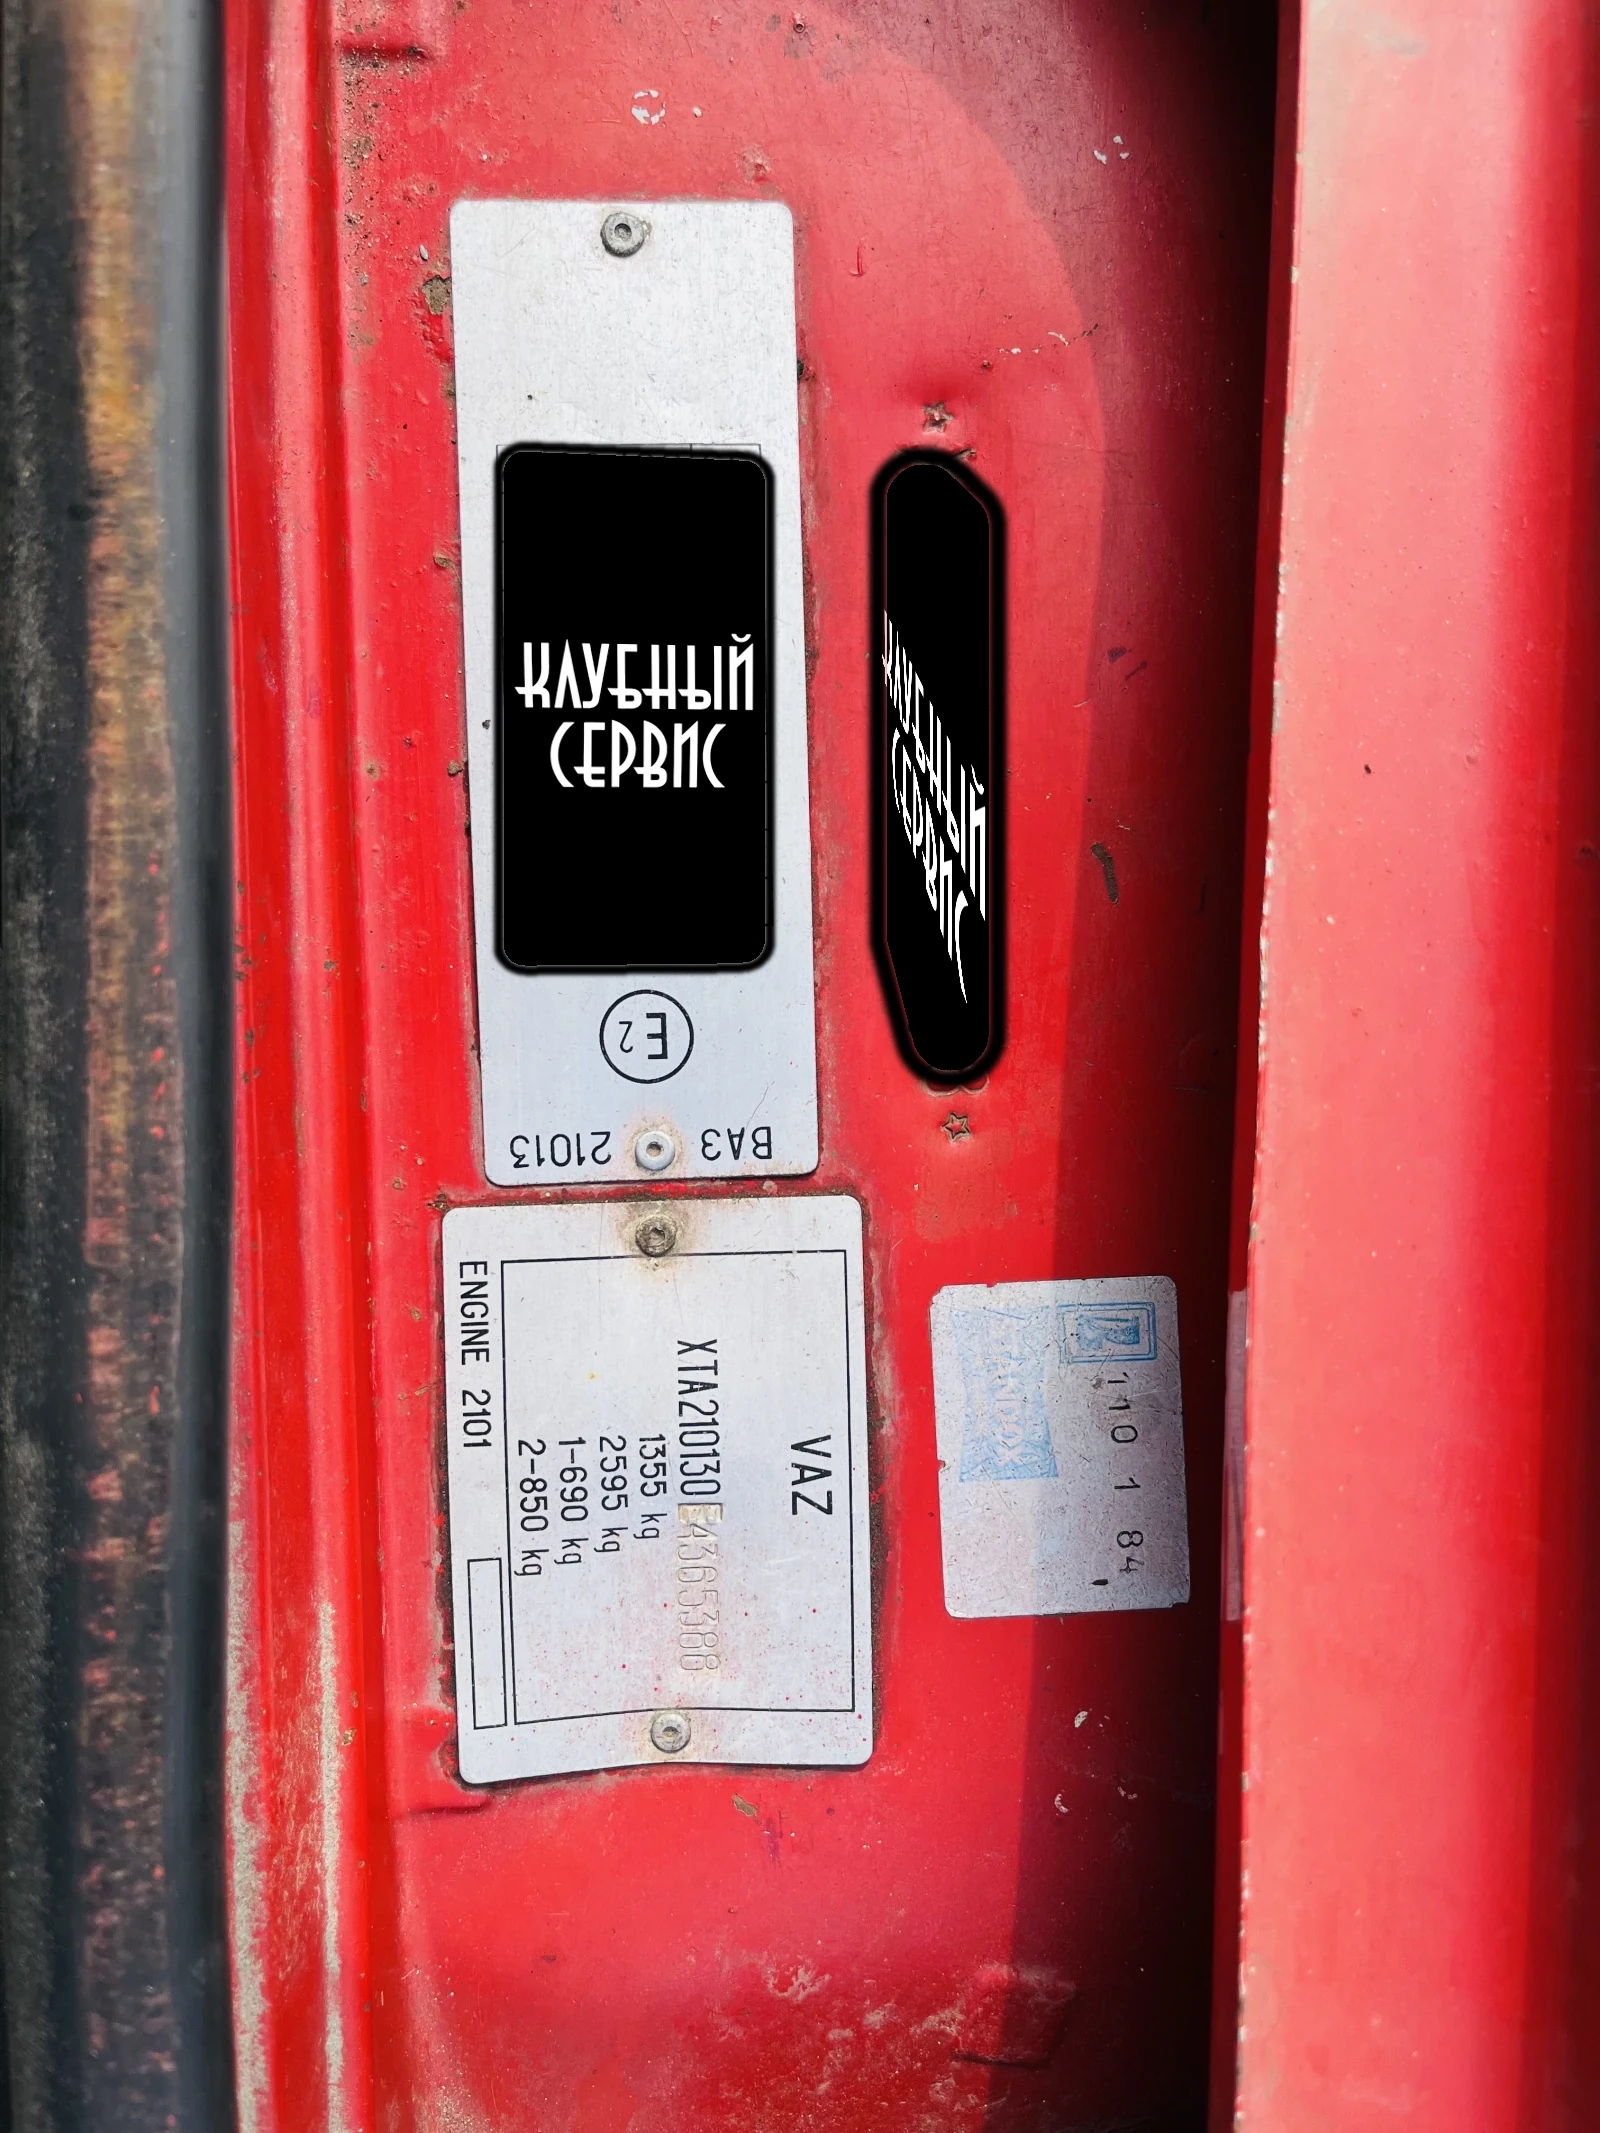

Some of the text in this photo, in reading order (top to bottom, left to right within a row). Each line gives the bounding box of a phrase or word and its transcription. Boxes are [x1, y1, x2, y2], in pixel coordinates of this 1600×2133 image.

[509, 1130, 612, 1169] 21013
[459, 1260, 492, 1448] ENGINE 2101
[514, 1438, 550, 1577] 2-850 kg
[554, 1436, 590, 1566] 1-690 kg
[594, 1435, 629, 1553] 2595 kg
[633, 1433, 668, 1541] 1355 kg
[791, 1434, 833, 1515] VAZ
